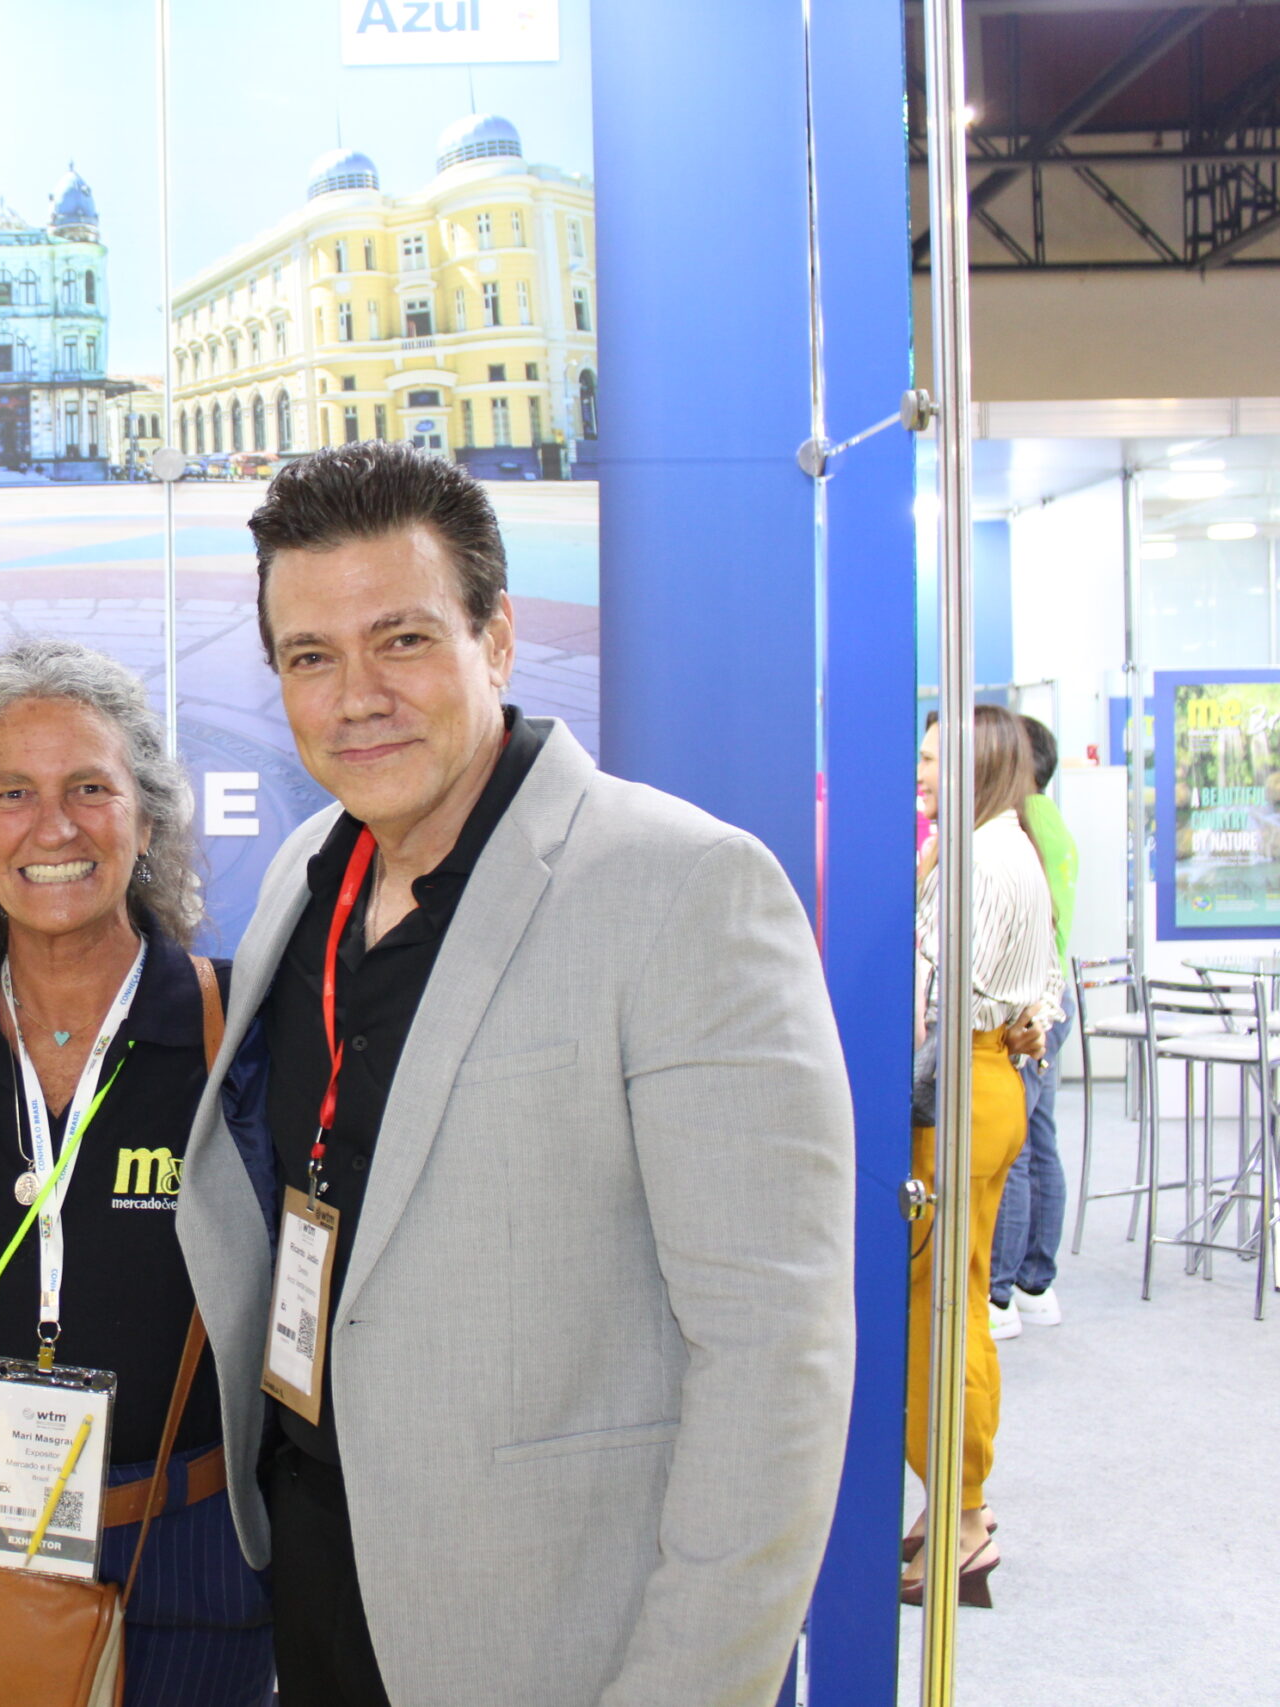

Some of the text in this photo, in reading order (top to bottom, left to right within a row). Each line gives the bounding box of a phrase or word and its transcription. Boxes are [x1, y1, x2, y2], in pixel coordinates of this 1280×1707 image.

[356, 0, 480, 33] Azul
[1190, 786, 1268, 809] A BEAUTIFUL
[1191, 811, 1249, 831] COUNTRY
[1211, 830, 1257, 852] NATURE
[32, 1100, 40, 1124] BRASIL
[36, 1134, 46, 1171] CONHEÇA
[36, 1410, 67, 1423] wtm
[12, 1430, 32, 1441] Mari
[25, 1447, 61, 1459] Expositor
[7, 1535, 62, 1551] EXHITOR
